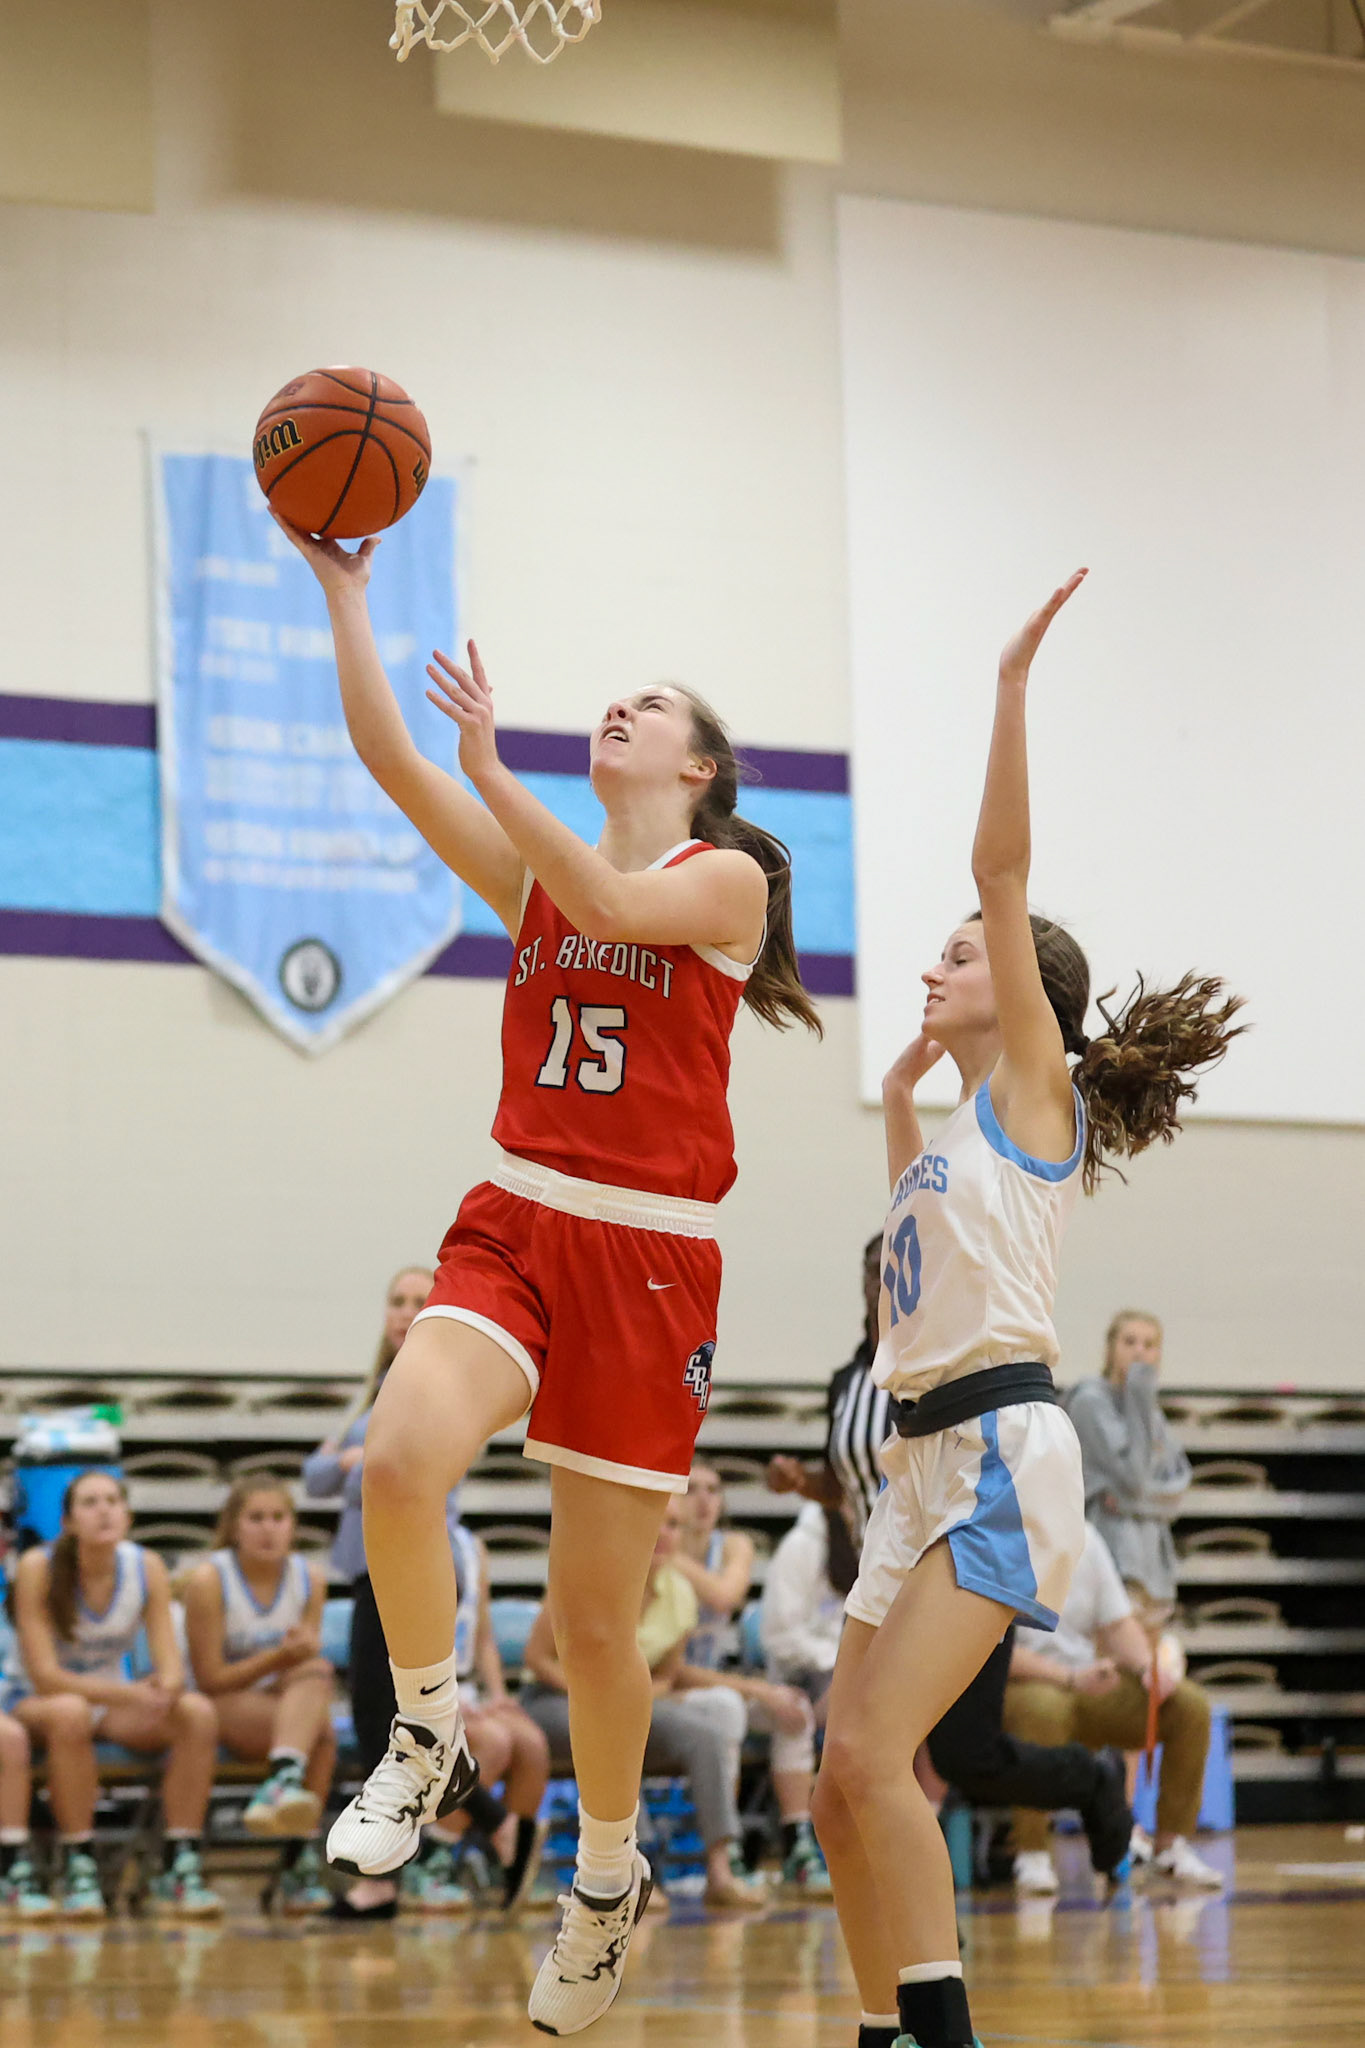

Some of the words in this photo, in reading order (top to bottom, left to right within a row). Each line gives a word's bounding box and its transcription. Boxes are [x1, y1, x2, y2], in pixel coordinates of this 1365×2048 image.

[253, 418, 303, 468] Wil
[514, 936, 546, 987] ST.
[555, 933, 675, 999] BENEDICT
[534, 995, 628, 1095] 15
